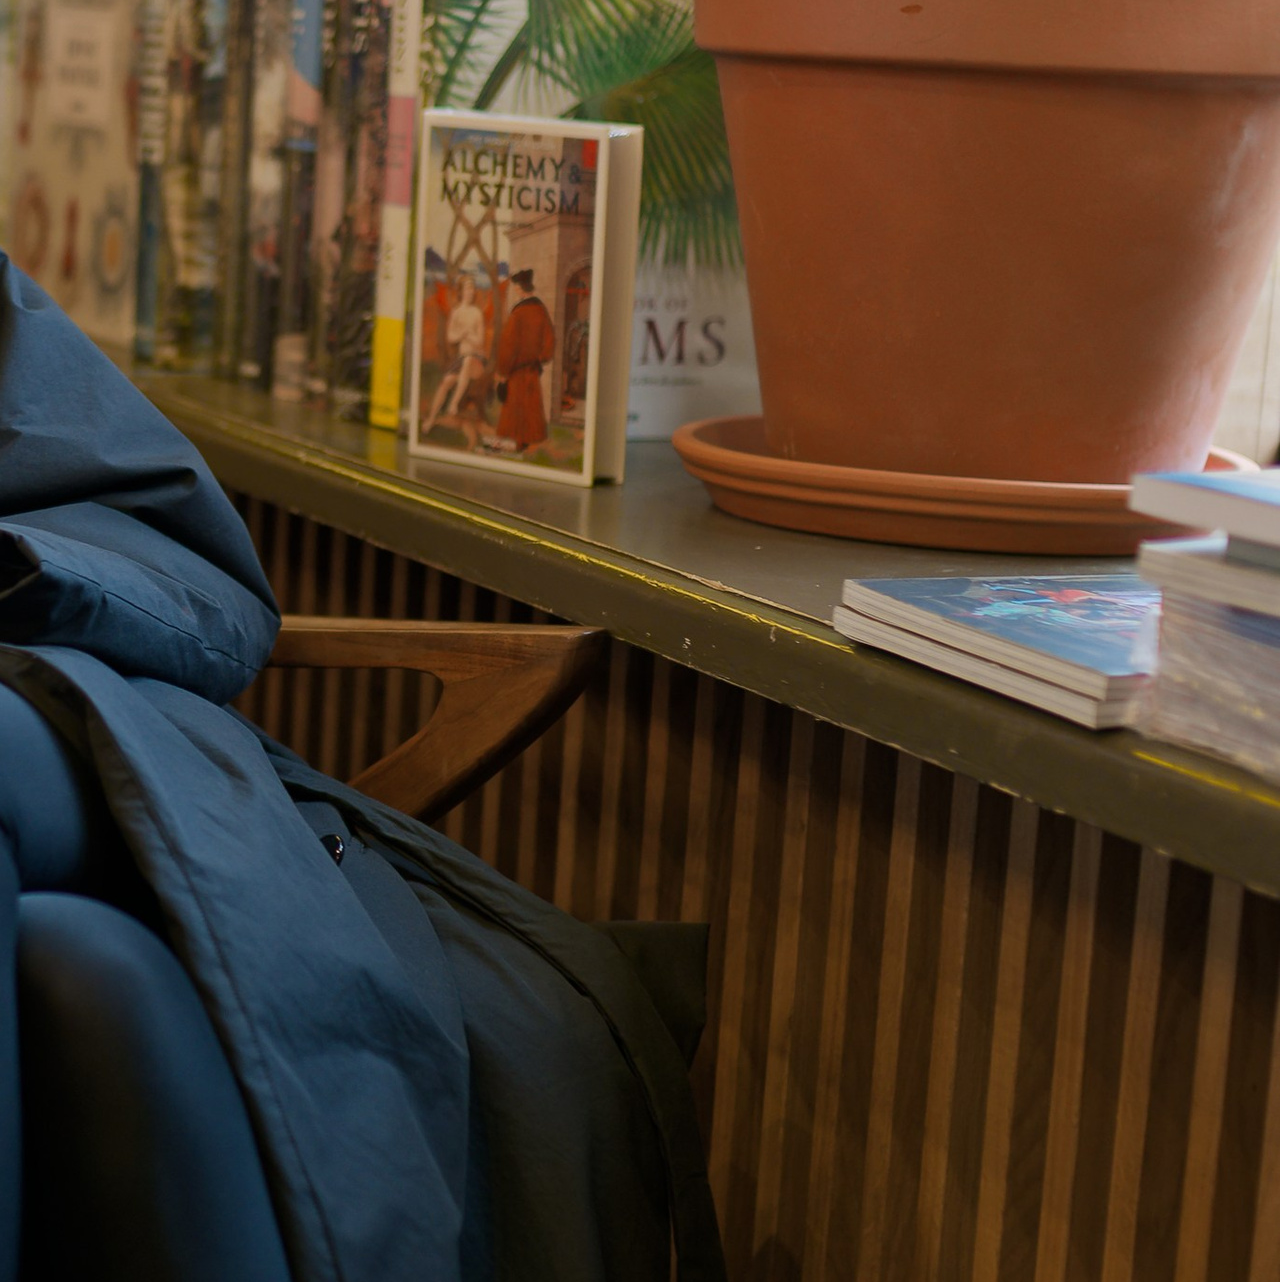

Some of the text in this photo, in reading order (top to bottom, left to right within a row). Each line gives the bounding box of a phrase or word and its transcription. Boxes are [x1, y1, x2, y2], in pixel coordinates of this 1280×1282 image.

[442, 148, 583, 185] ALCHEMY &
[441, 180, 580, 215] MYSTICISM
